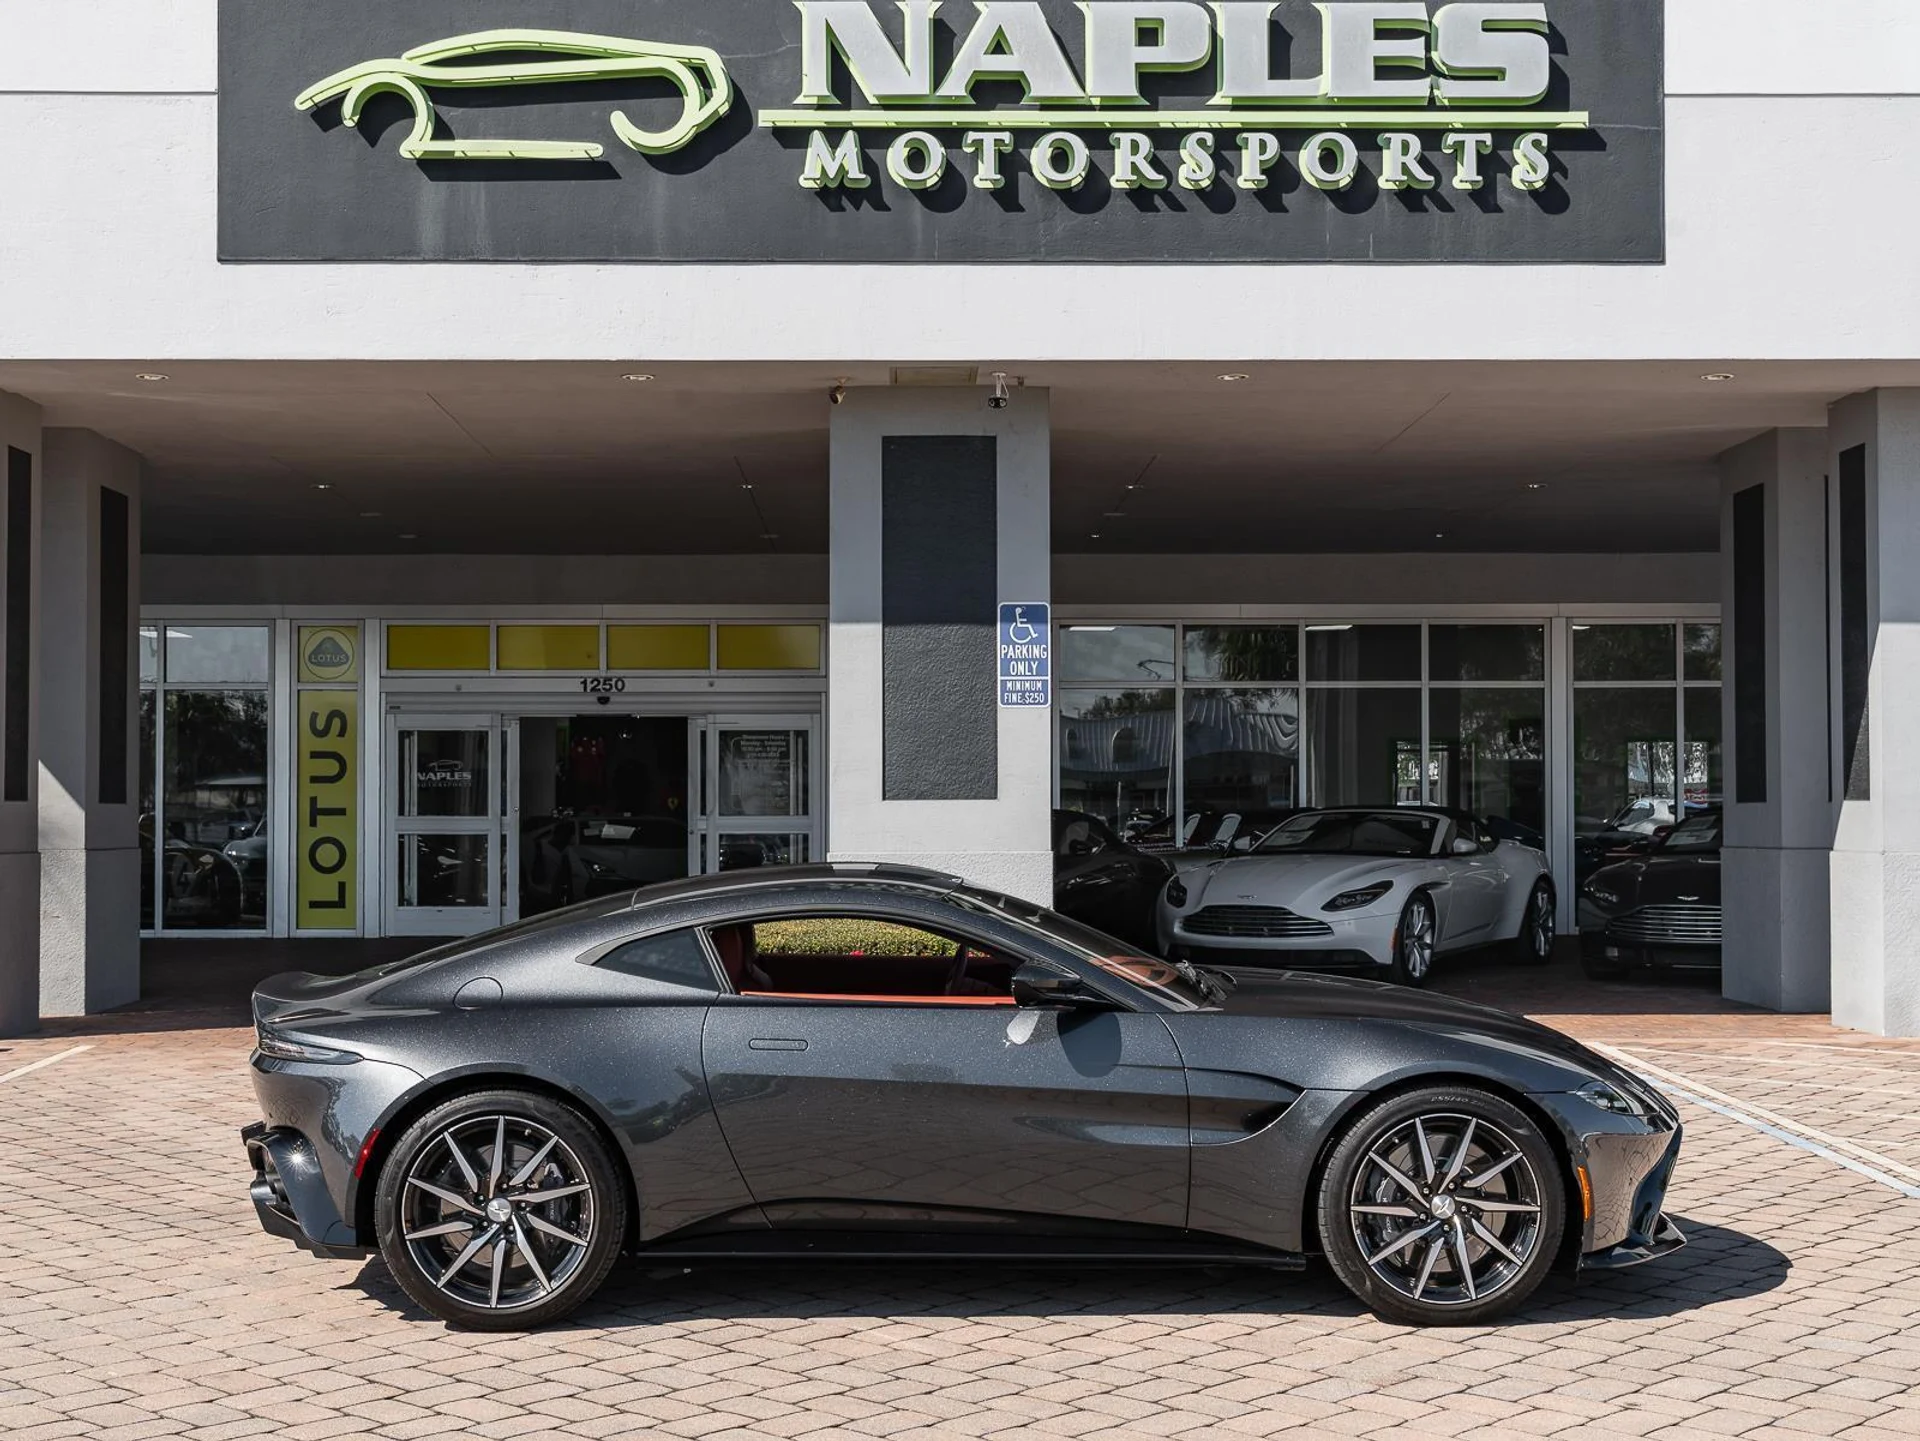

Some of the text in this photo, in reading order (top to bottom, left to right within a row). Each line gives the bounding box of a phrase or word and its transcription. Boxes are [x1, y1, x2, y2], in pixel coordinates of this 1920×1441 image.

[792, 1, 1550, 106] NAPLES
[799, 129, 1550, 190] MOTORSPORTS
[311, 653, 347, 663] LOTUS
[1001, 644, 1047, 659] PARKING
[1010, 660, 1038, 676] ONLY
[580, 677, 625, 692] 1250
[1006, 681, 1042, 692] MINIMUM
[417, 771, 472, 780] NAPLES
[309, 709, 347, 909] LOTUS
